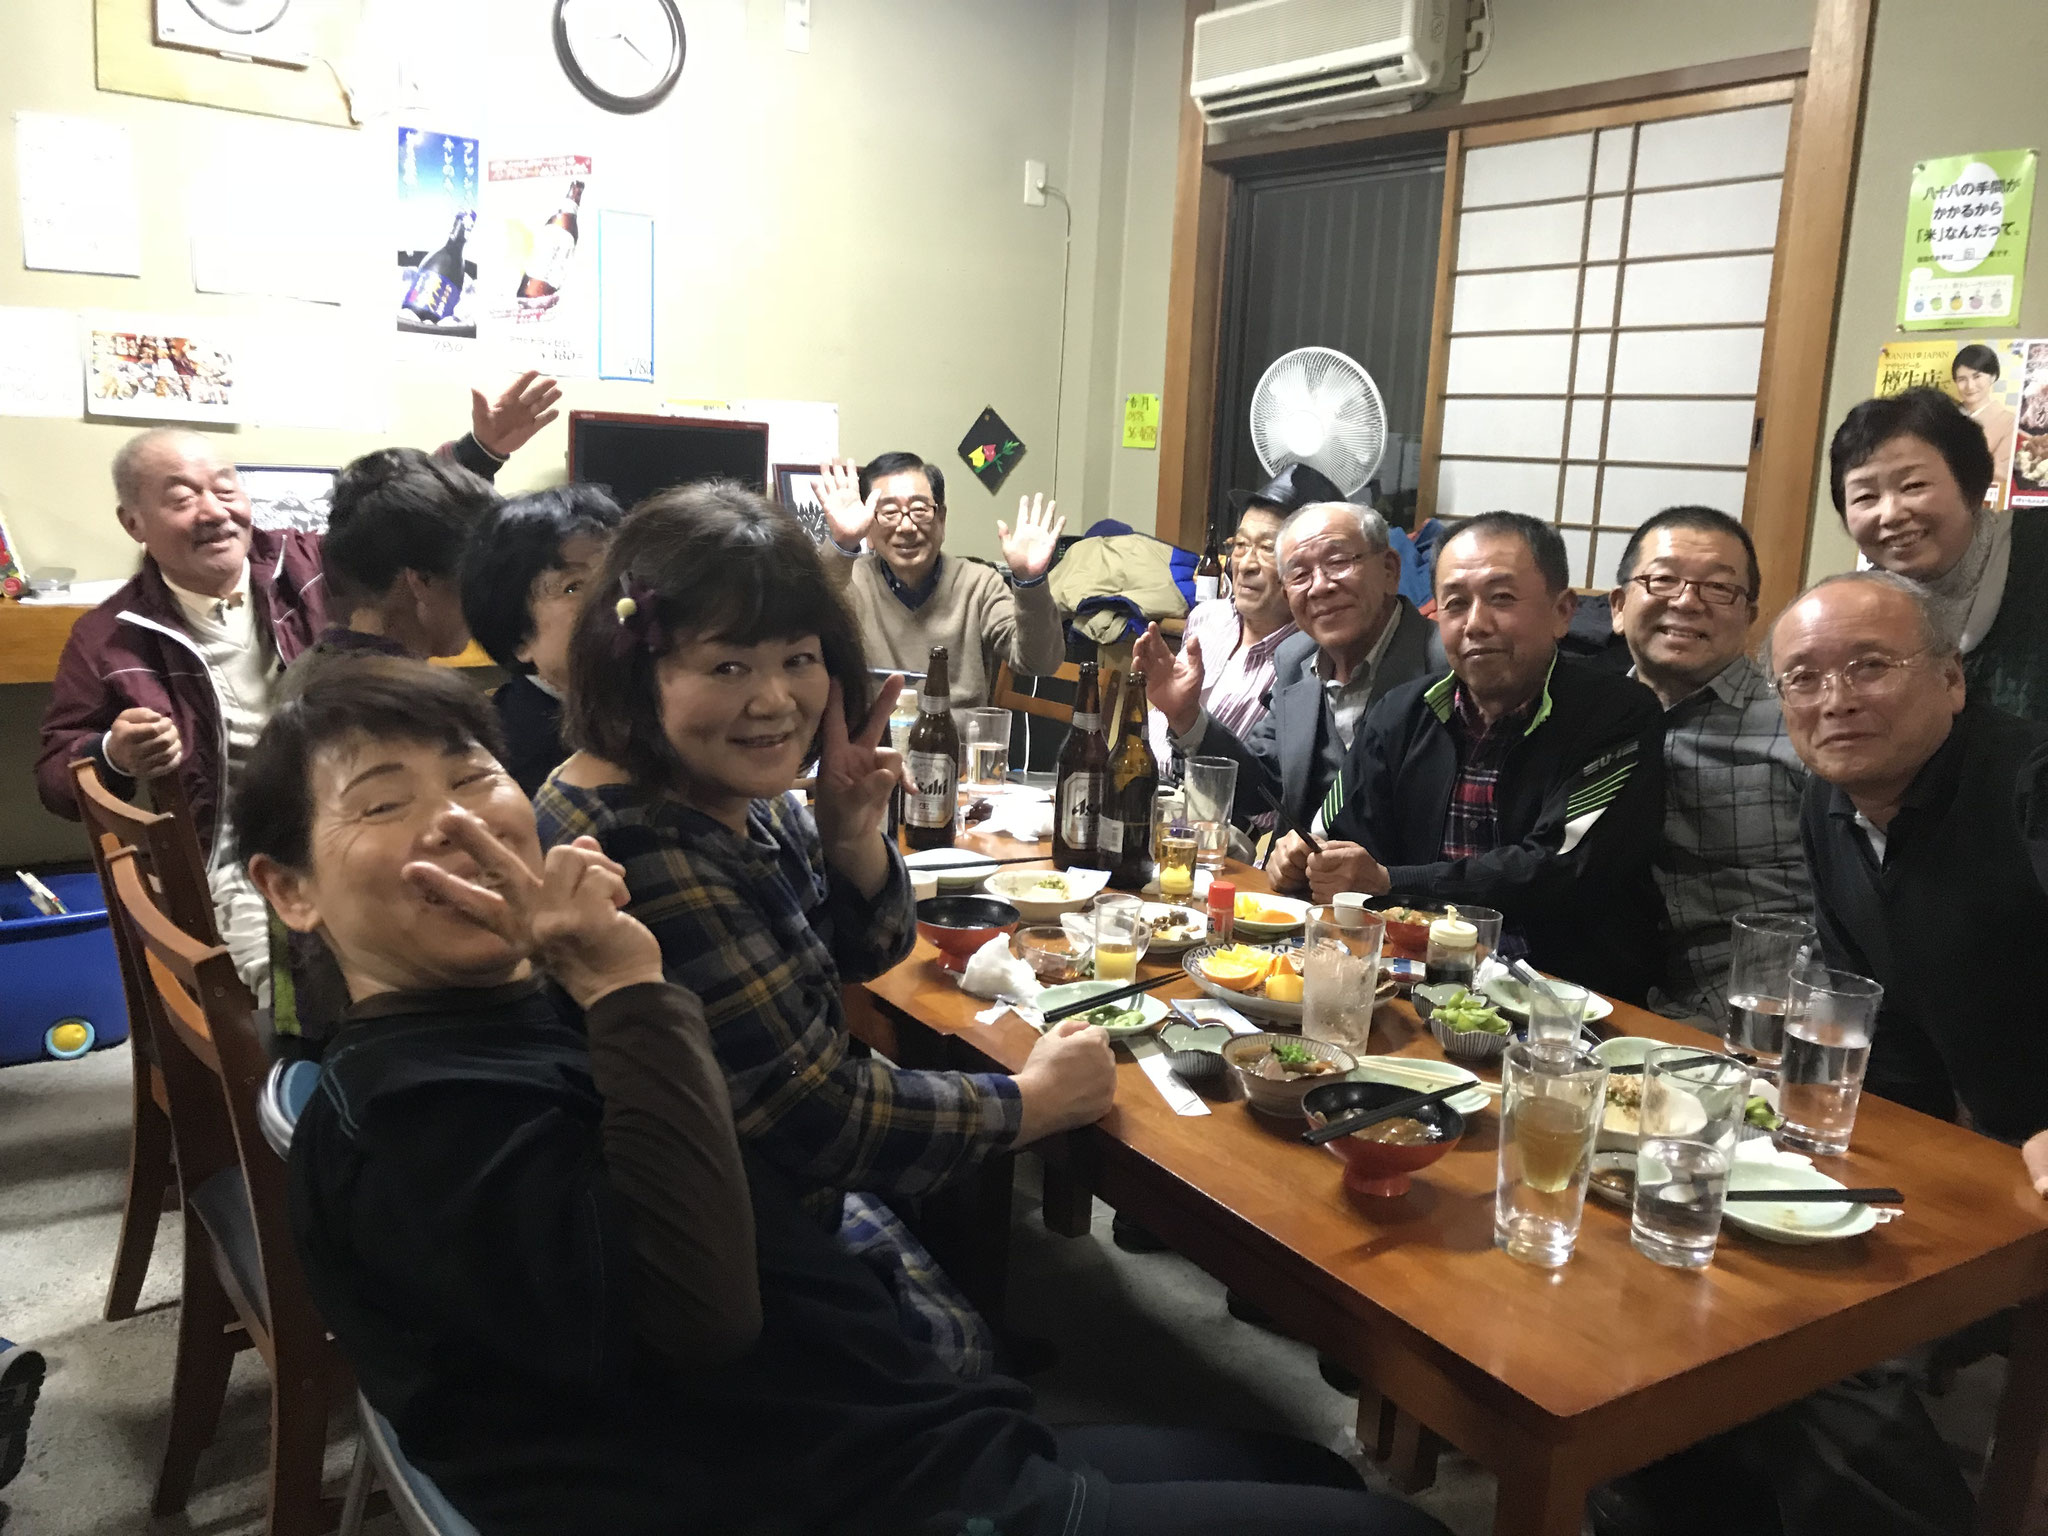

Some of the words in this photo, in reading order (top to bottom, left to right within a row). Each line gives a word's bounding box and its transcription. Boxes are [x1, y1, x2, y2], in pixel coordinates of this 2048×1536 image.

[1922, 178, 2022, 201] 八十八の手間が
[1933, 201, 2002, 220] かかるから
[1916, 221, 2020, 243] 「米」なんだって。
[1923, 350, 1950, 360] JAPAN
[914, 777, 949, 796] sahi
